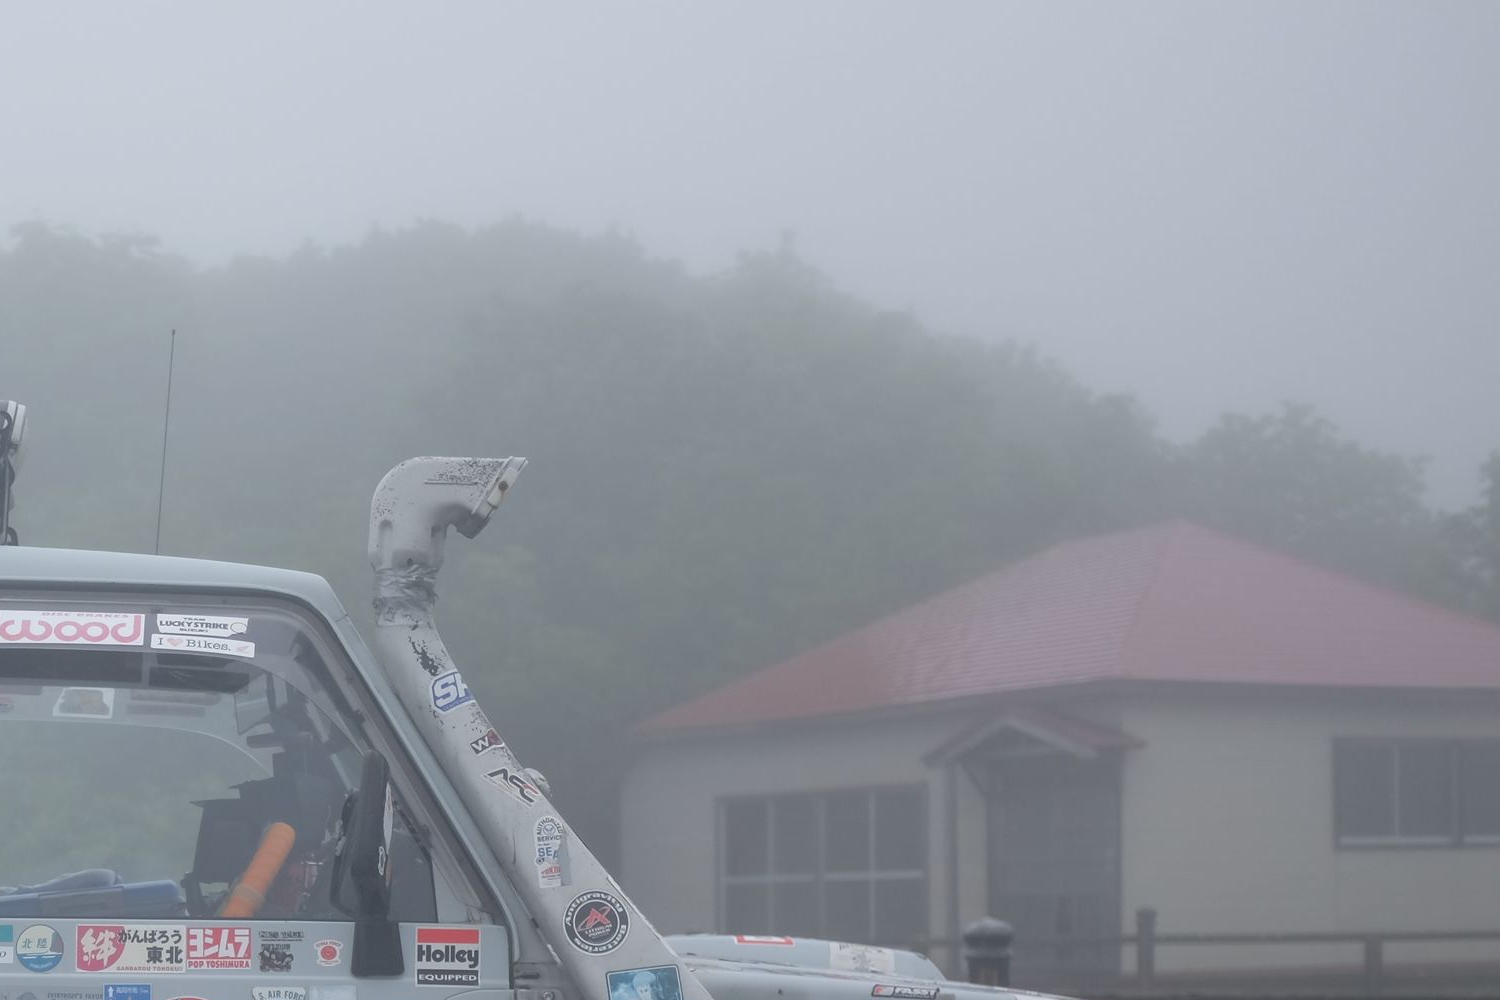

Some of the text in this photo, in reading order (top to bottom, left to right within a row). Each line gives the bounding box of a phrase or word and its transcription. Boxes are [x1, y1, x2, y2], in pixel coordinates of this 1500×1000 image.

[159, 620, 229, 631] LUCKY STRIKE
[118, 930, 182, 944] がんばろう
[190, 928, 251, 958] ヨシムラ
[147, 946, 183, 965] 東北
[417, 944, 479, 968] Holley
[188, 960, 250, 969] POP YOSHIMURA
[418, 973, 477, 982] EQUIPPED
